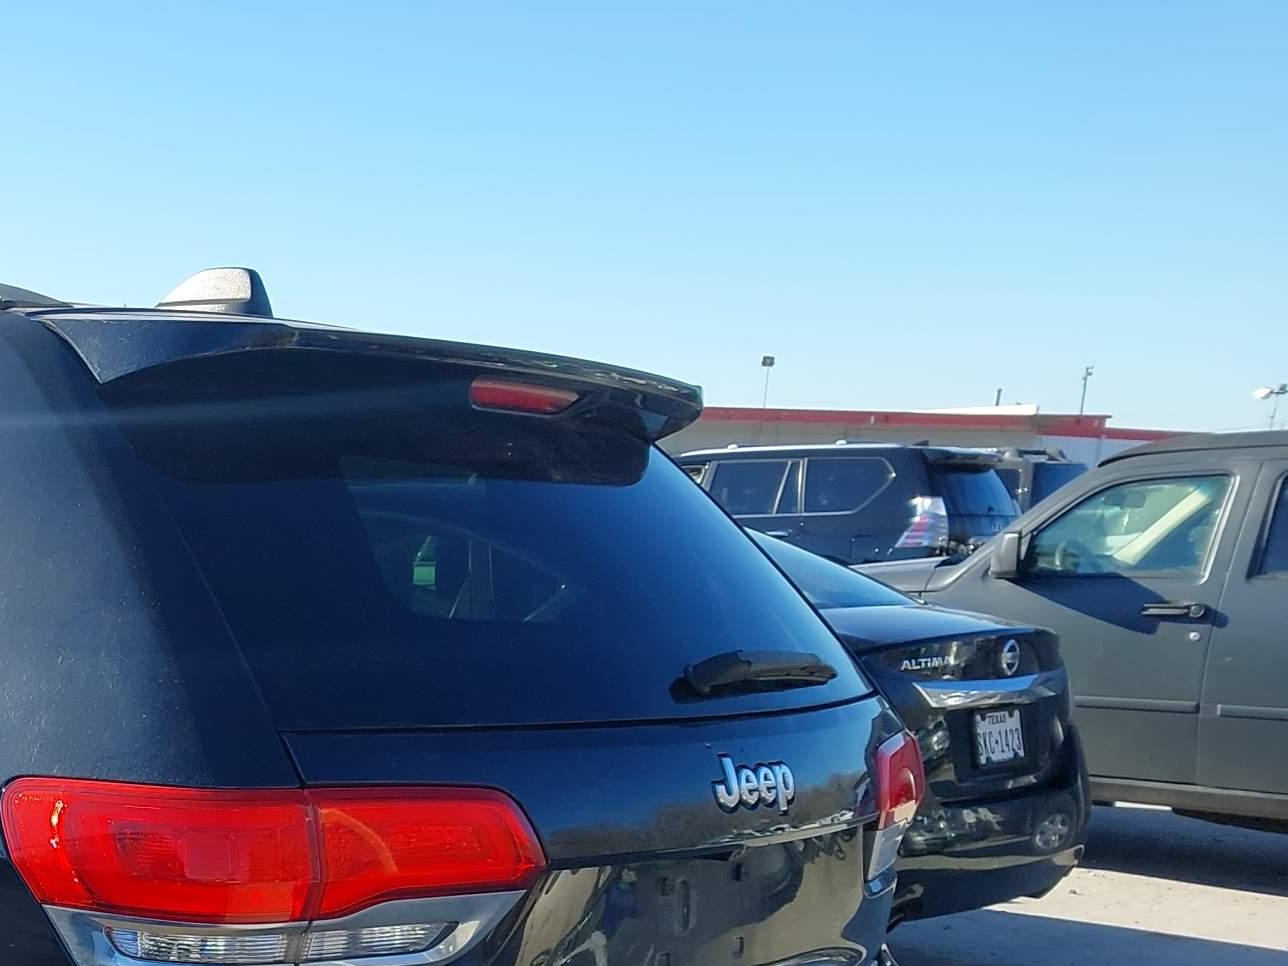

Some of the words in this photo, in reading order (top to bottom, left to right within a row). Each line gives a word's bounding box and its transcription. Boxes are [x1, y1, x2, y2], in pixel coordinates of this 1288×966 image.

[900, 656, 955, 671] ALTIMA
[987, 714, 1008, 726] TEXAS
[712, 754, 796, 813] Jeep
